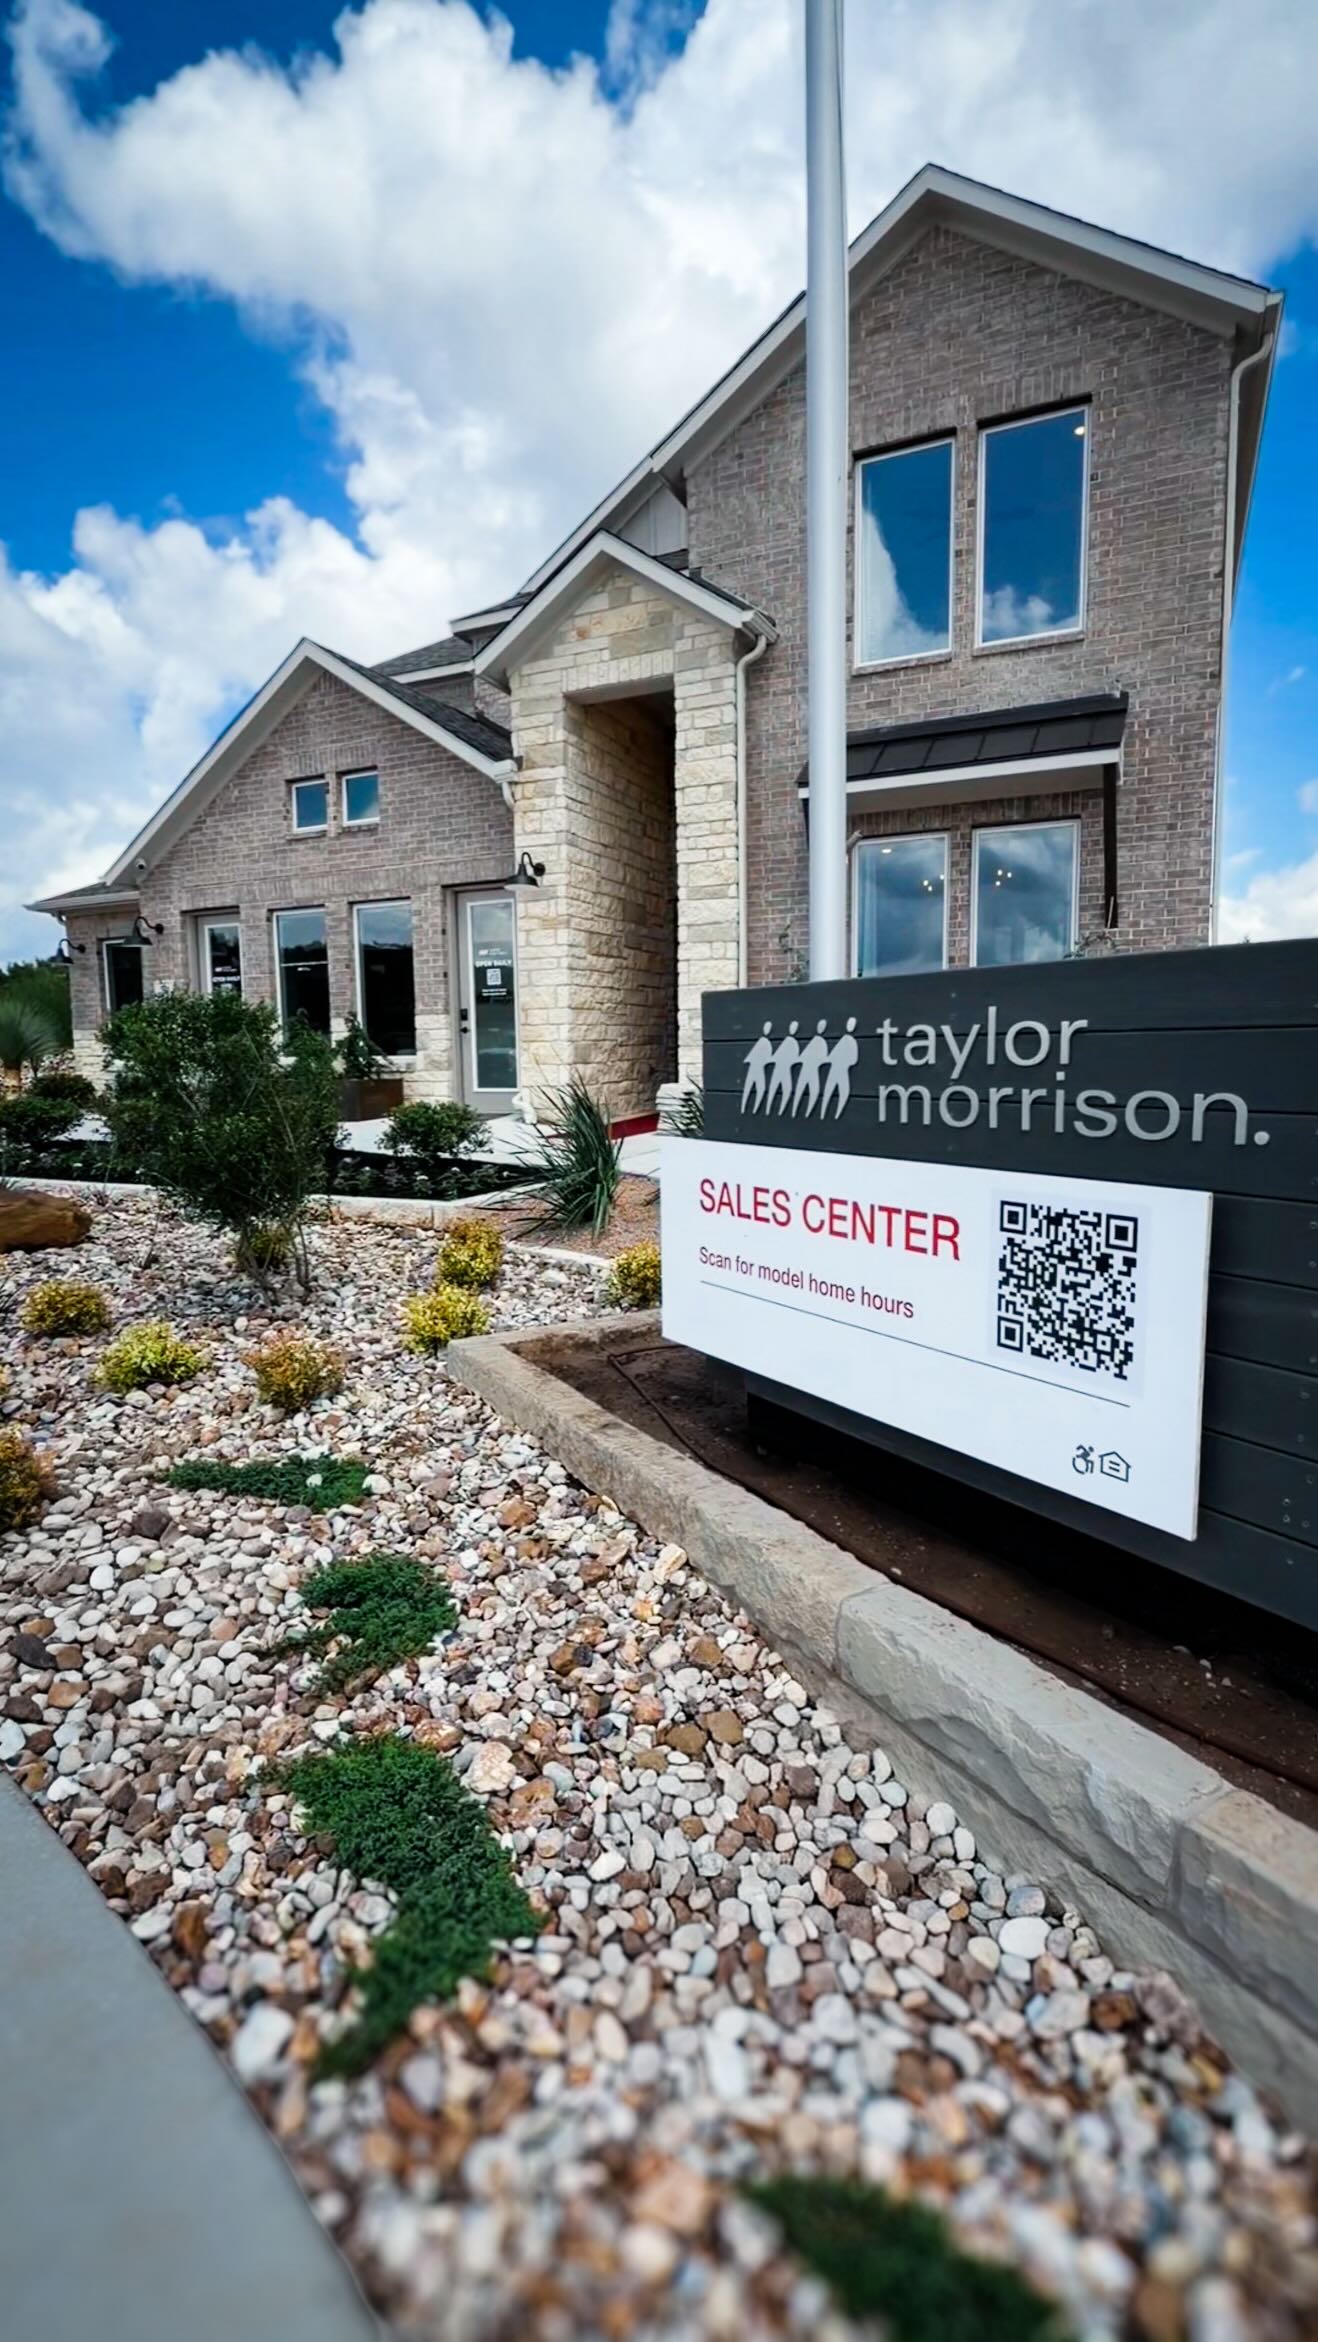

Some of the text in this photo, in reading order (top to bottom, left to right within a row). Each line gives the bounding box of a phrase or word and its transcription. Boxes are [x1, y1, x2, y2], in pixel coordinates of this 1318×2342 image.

[876, 1005, 1089, 1080] taylor
[878, 1071, 1271, 1146] morrison.
[700, 1178, 961, 1261] SALES CENTER
[699, 1245, 915, 1319] Scan for model home hours
